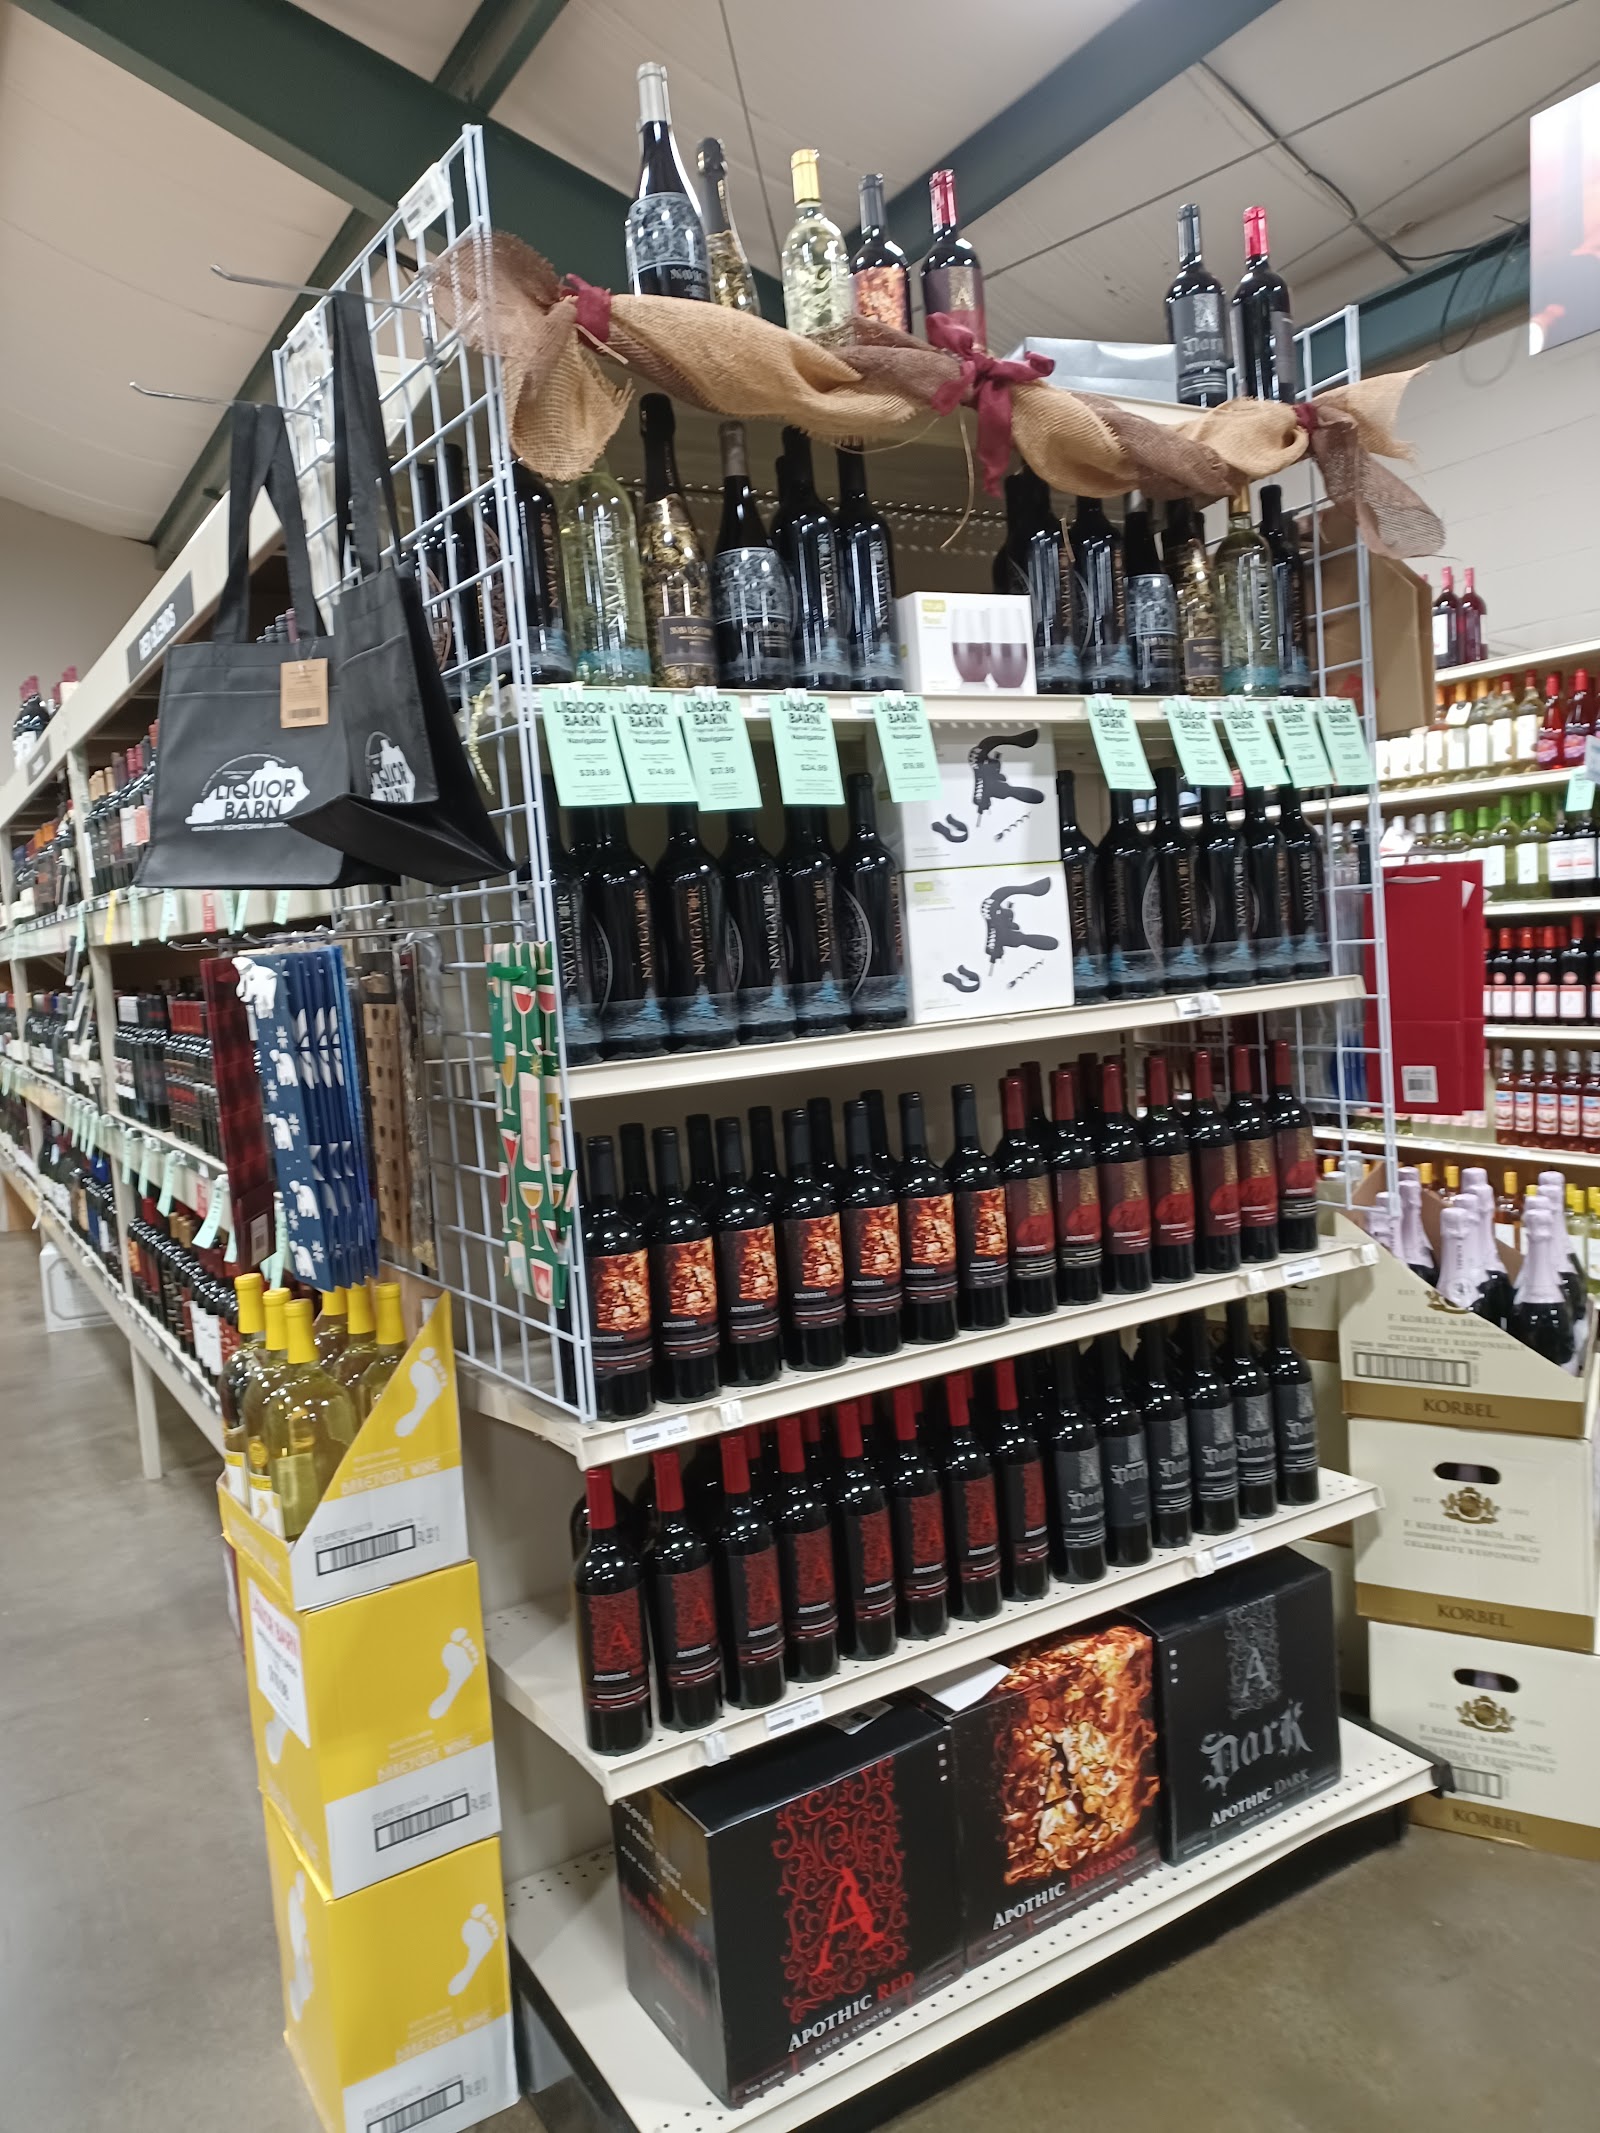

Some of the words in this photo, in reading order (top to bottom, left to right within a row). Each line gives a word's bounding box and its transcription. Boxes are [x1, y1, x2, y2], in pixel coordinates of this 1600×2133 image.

[553, 701, 607, 714] LIQUOR
[564, 715, 601, 727] BARN
[619, 703, 668, 716] LIQUOR
[683, 701, 732, 714] LIQUOR
[694, 713, 728, 726] BARN
[629, 716, 664, 728] BARN
[216, 779, 296, 801] LIQUOR
[224, 799, 281, 820] BARN
[633, 888, 653, 980] NAVIGATOR
[688, 885, 707, 976] NAVIGATOR
[763, 885, 781, 970] NAVIGATOR
[813, 879, 831, 963] NAVIGATOR
[557, 893, 578, 990] NAVIGATOR
[1423, 1397, 1498, 1419] KORBEL
[1437, 1603, 1513, 1629] KORBEL
[1210, 1787, 1272, 1828] APOTHIC
[1274, 1767, 1310, 1795] DARK
[1452, 1808, 1528, 1836] KORBEL
[992, 1881, 1067, 1931] APOTHIC
[1069, 1845, 1138, 1890] INFERNO
[787, 1994, 873, 2053] APOTHIC
[877, 1971, 915, 2001] RED
[851, 2006, 893, 2034] SMOOTH
